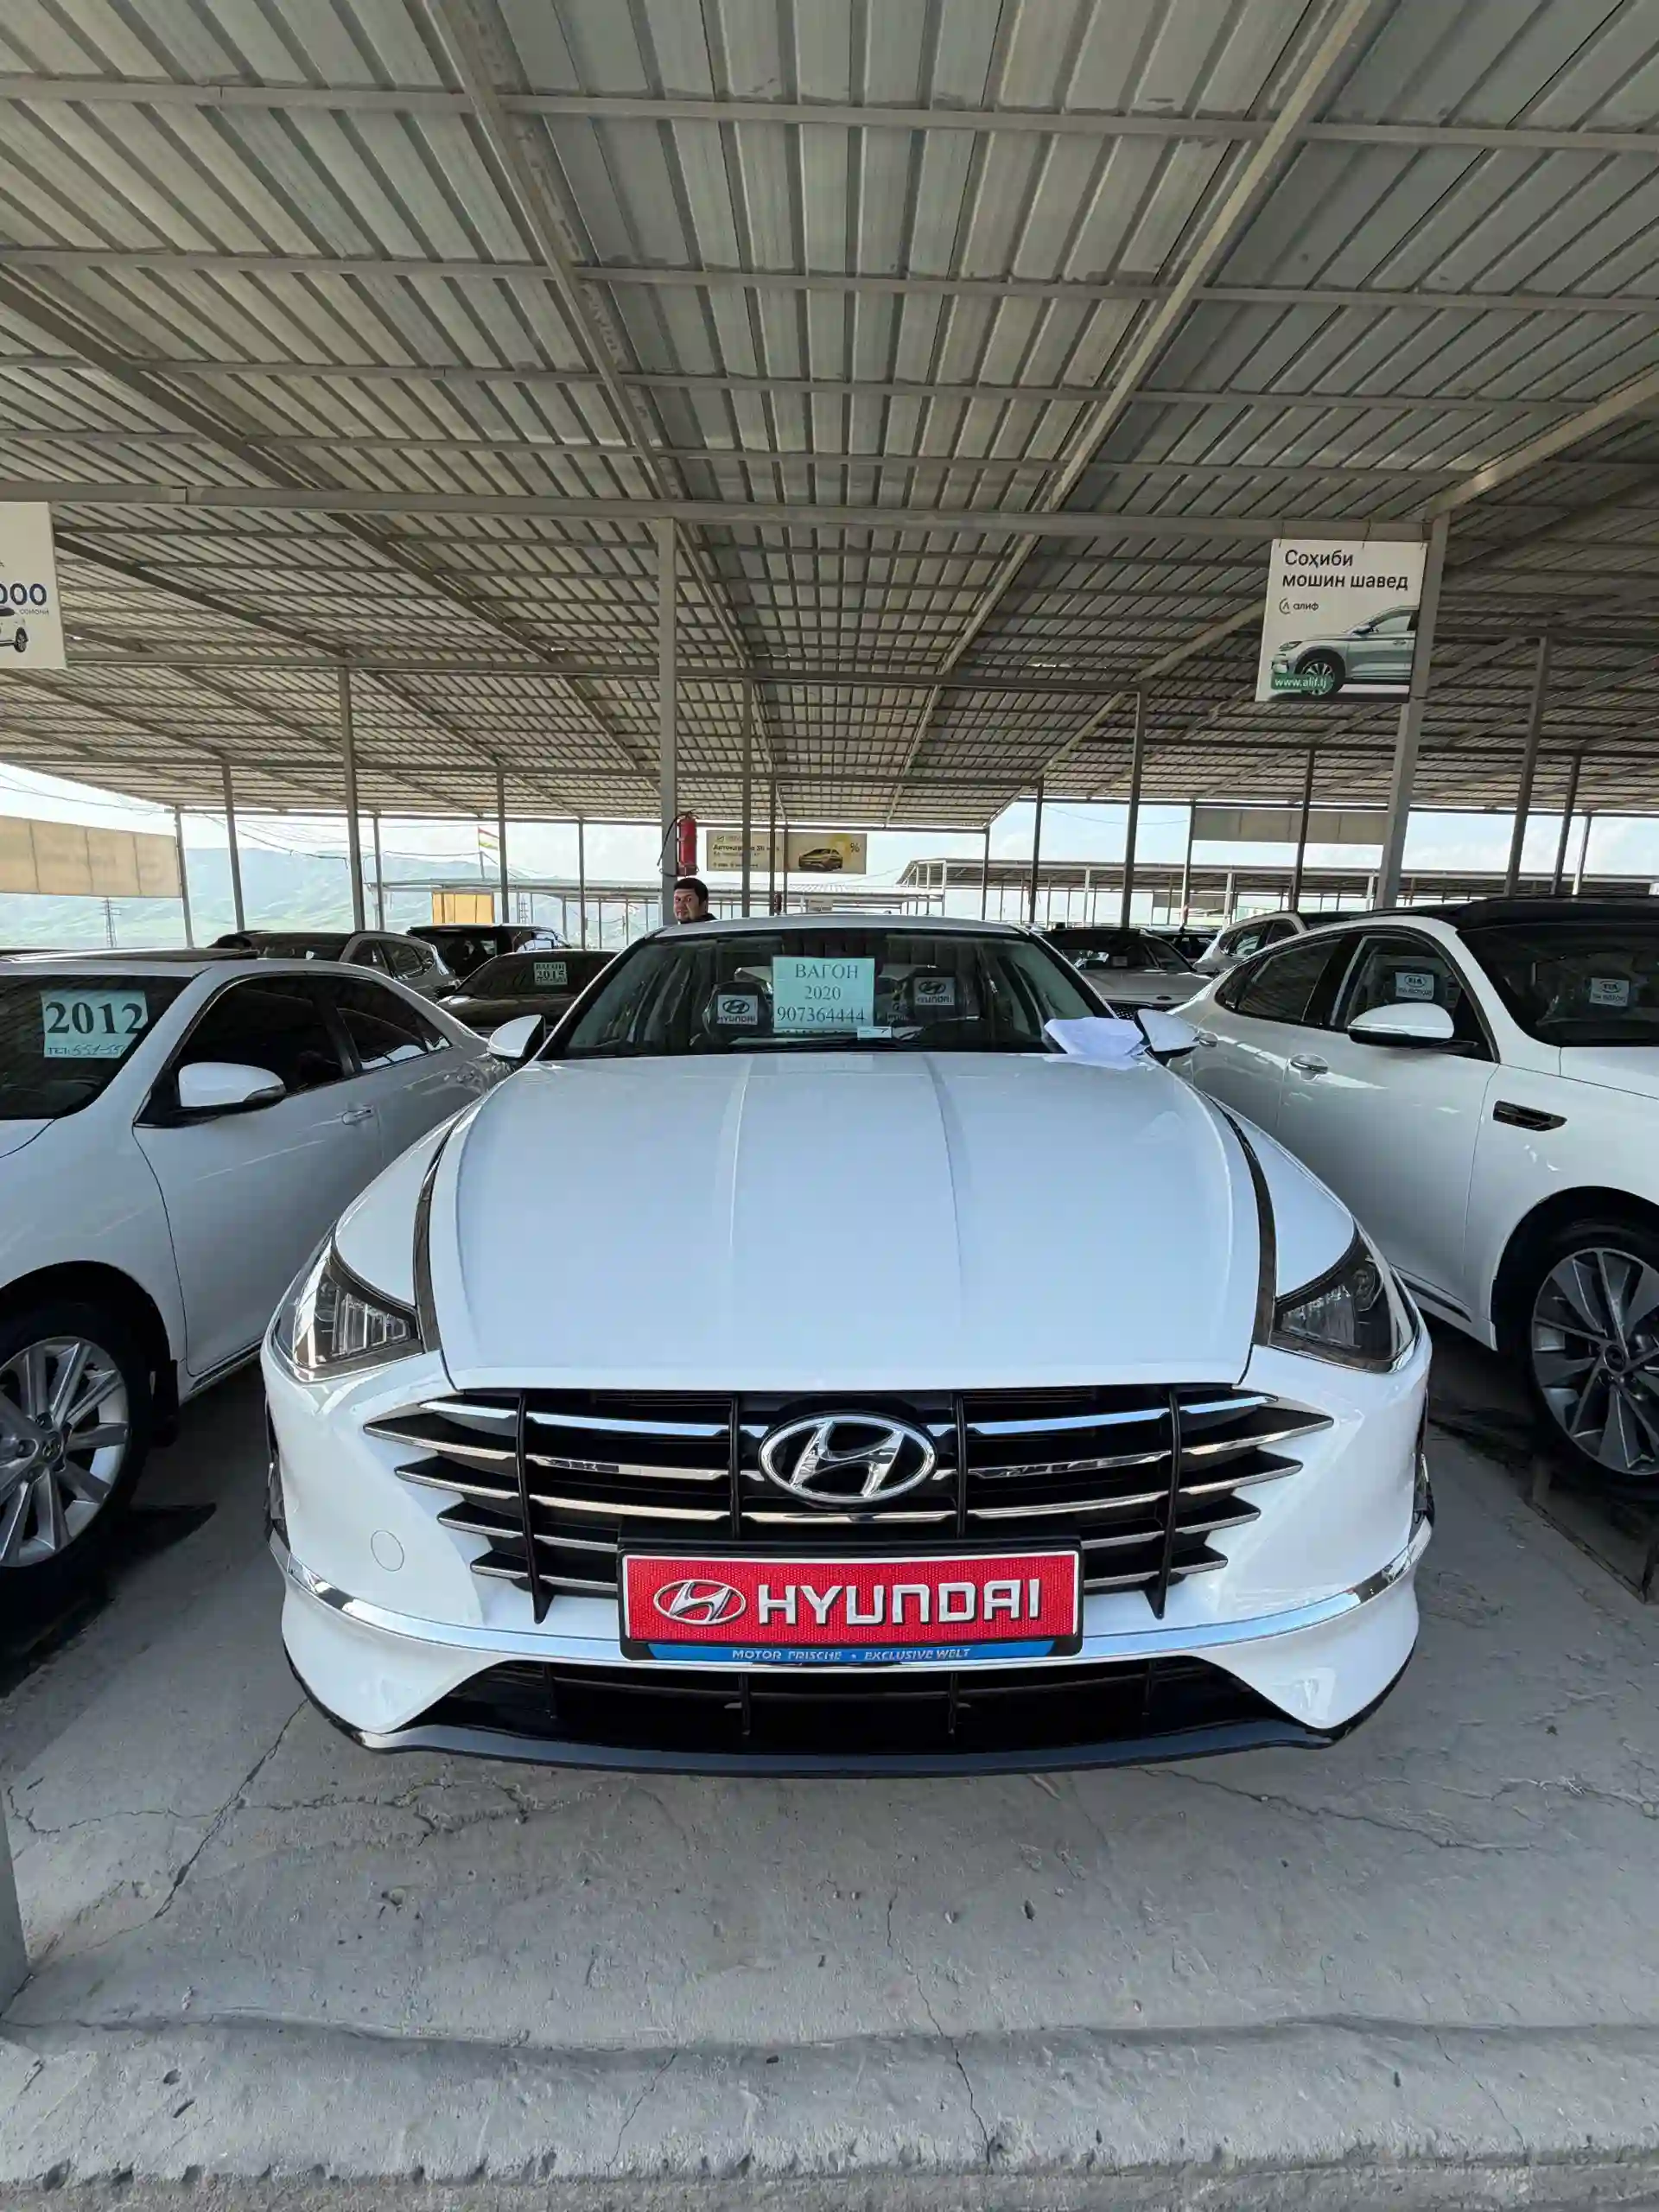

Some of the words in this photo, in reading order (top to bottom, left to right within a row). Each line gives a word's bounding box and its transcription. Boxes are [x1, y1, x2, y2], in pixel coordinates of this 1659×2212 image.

[1284, 550, 1354, 569] Соҳиби
[1282, 575, 1345, 588] мошин
[1350, 575, 1408, 591] шавед
[1293, 602, 1319, 612] алиф
[795, 963, 859, 979] ВАГОН
[804, 986, 842, 1001] 2020
[46, 1001, 143, 1034] 2012
[777, 1006, 867, 1023] 907364444
[757, 1578, 1041, 1625] HYUNDAI
[732, 1649, 782, 1659] MOTOR
[864, 1649, 934, 1660] EXCLUSIVE
[936, 1648, 971, 1658] WELT
